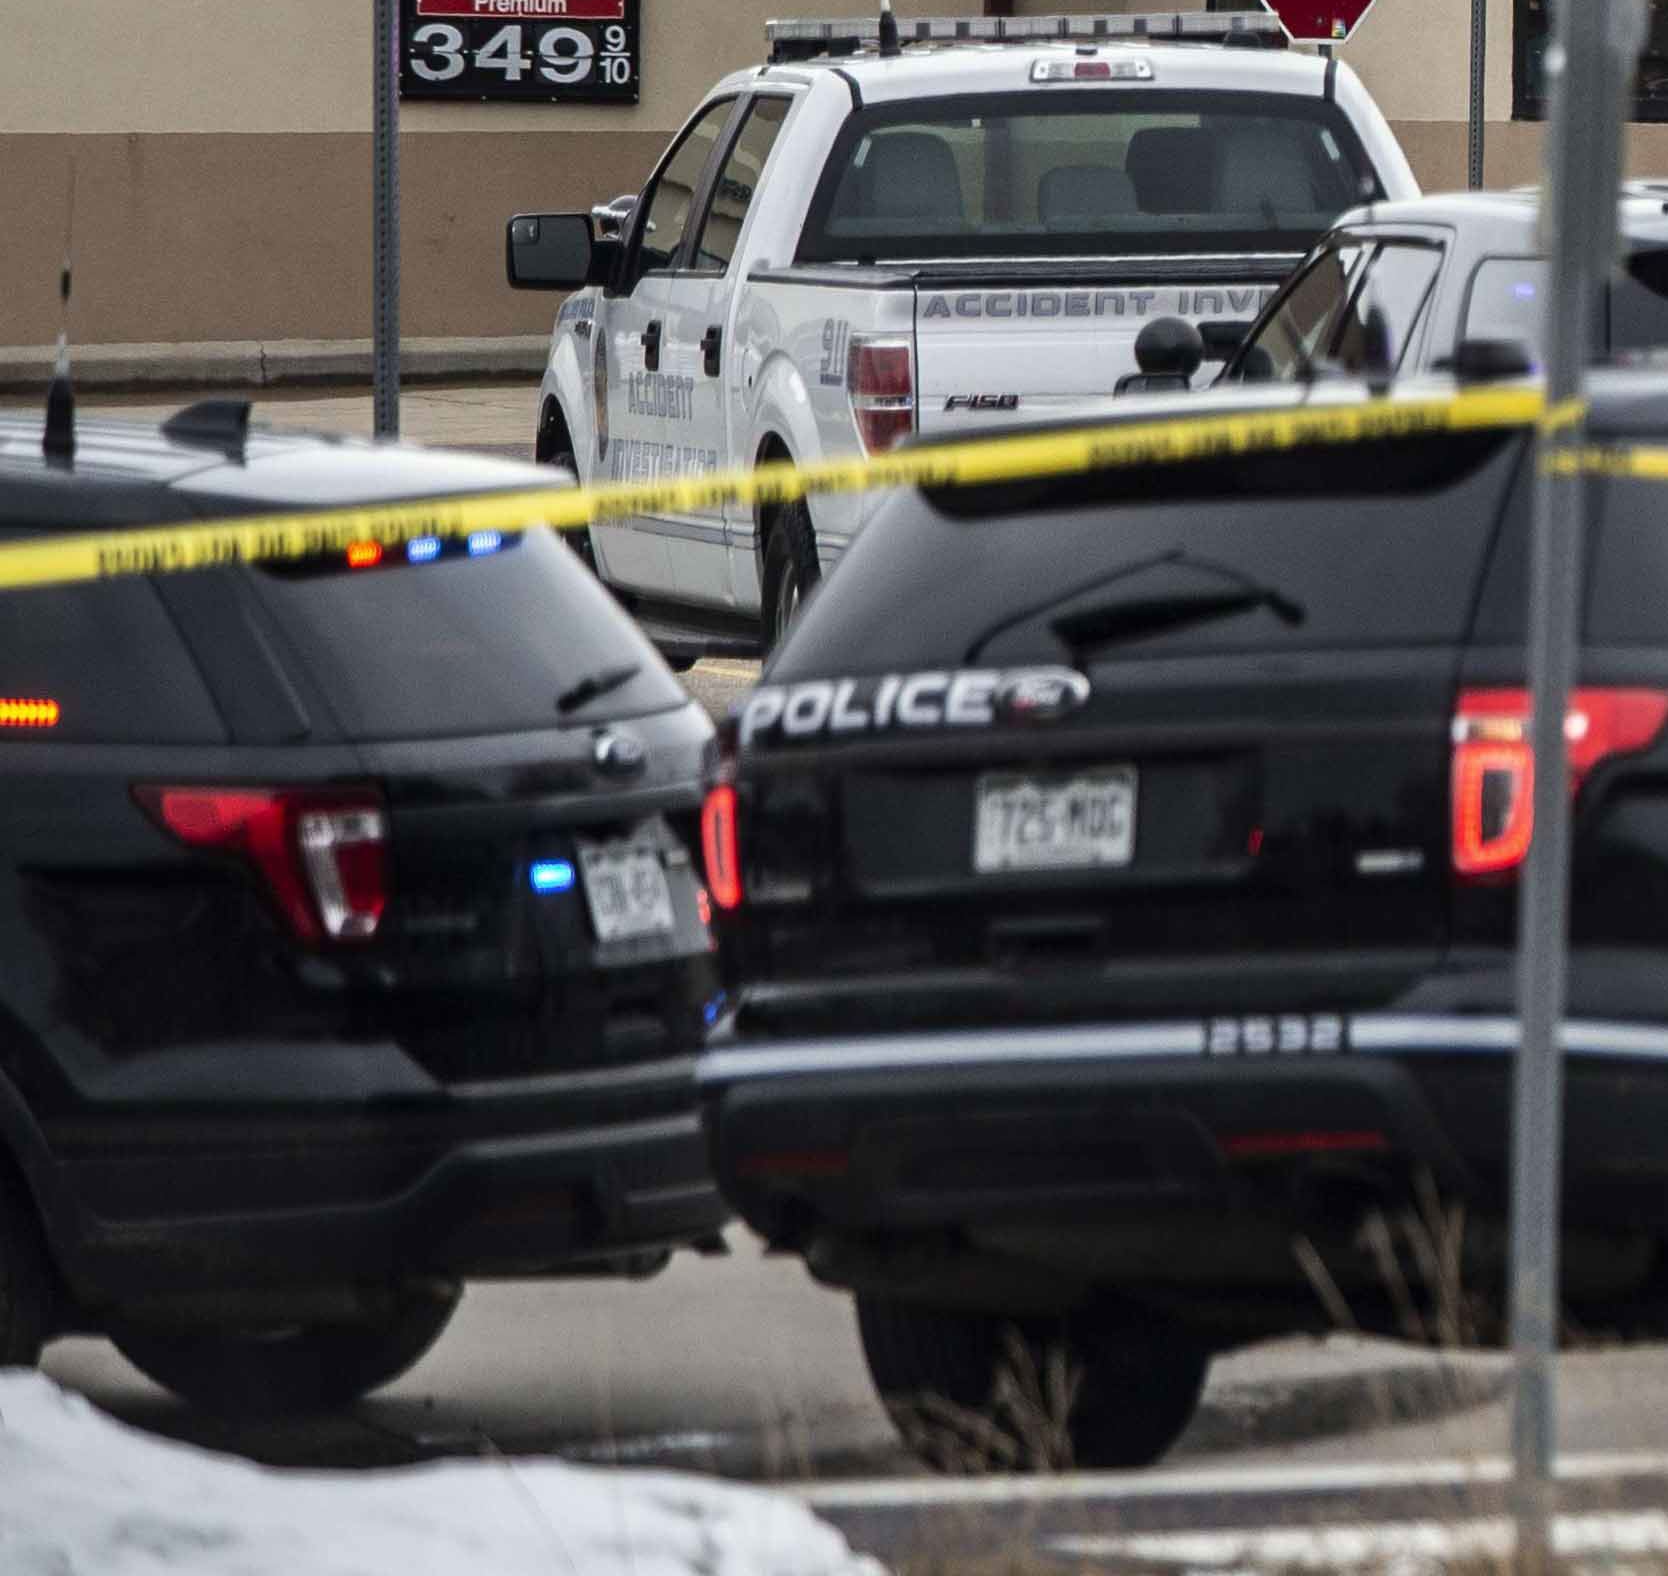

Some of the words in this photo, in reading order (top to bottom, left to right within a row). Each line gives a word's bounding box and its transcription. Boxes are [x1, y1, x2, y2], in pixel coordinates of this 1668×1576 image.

[410, 22, 595, 84] 349
[923, 290, 1155, 319] ACCIDENT
[1178, 289, 1267, 315] INV
[820, 318, 849, 375] 911
[740, 670, 1000, 746] POLICE
